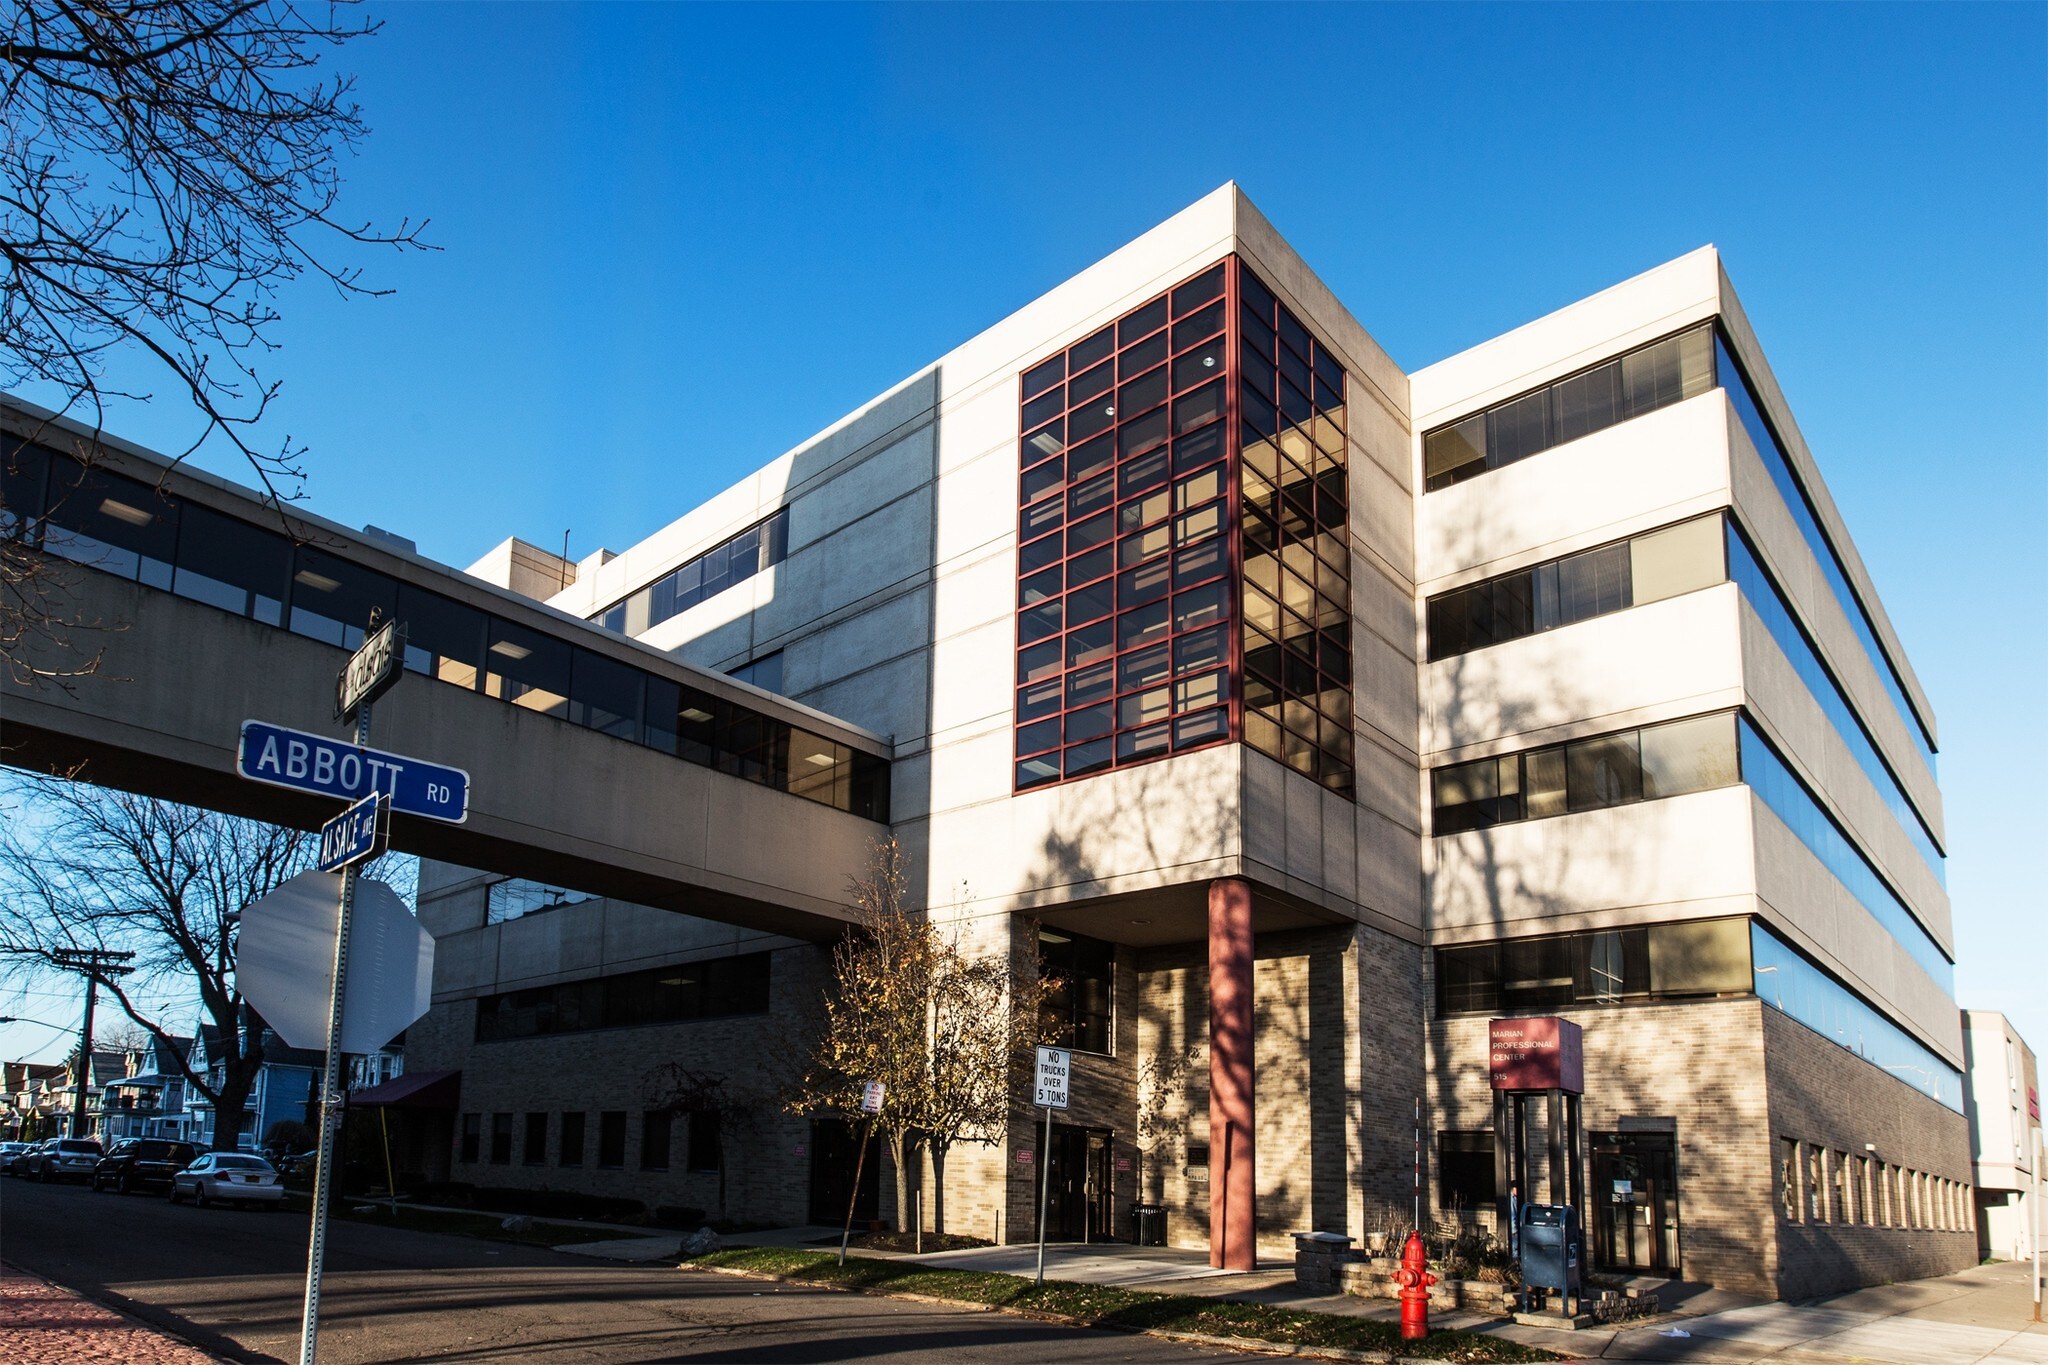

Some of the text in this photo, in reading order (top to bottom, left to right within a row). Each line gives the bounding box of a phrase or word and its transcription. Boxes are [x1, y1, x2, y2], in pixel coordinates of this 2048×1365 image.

[257, 735, 450, 804] ABBOTT RD
[321, 813, 373, 866] ALSACE AVE
[1492, 1030, 1523, 1038] MARIAN
[1492, 1041, 1554, 1049] PROFESSIONAL
[1048, 1051, 1060, 1063] NO
[1493, 1053, 1525, 1061] CENTER
[1040, 1064, 1066, 1076] TRUCKS
[1043, 1077, 1061, 1087] OVER
[1038, 1089, 1066, 1103] 5 TONS
